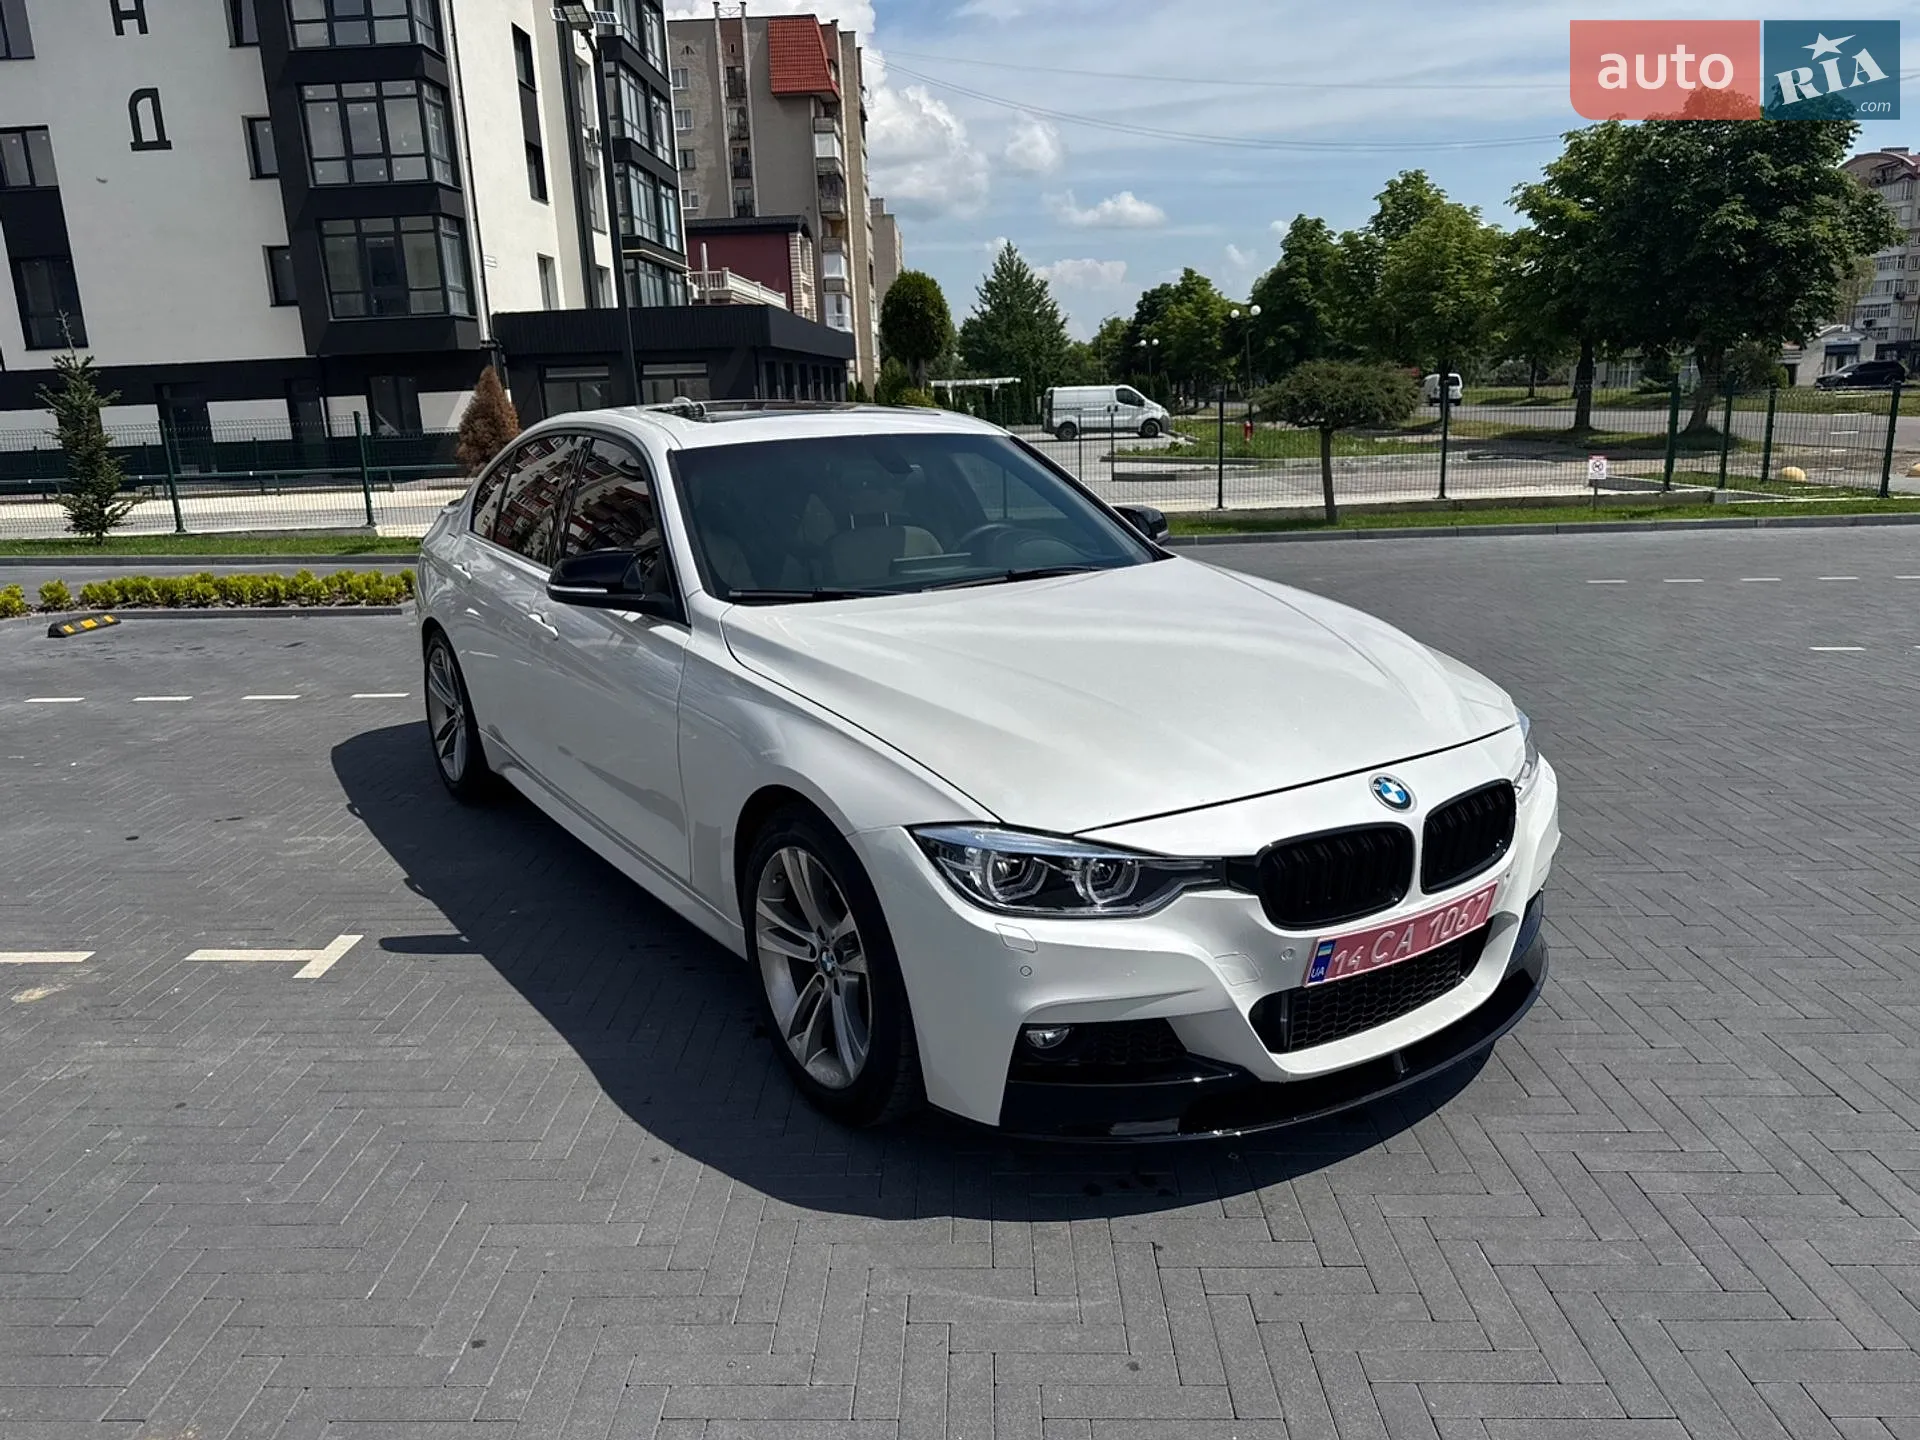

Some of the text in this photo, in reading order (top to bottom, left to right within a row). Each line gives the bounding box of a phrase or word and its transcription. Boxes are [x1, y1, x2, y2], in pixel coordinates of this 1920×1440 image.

[1334, 945, 1364, 975] 14
[1370, 923, 1416, 963] CA
[1310, 966, 1326, 979] UA
